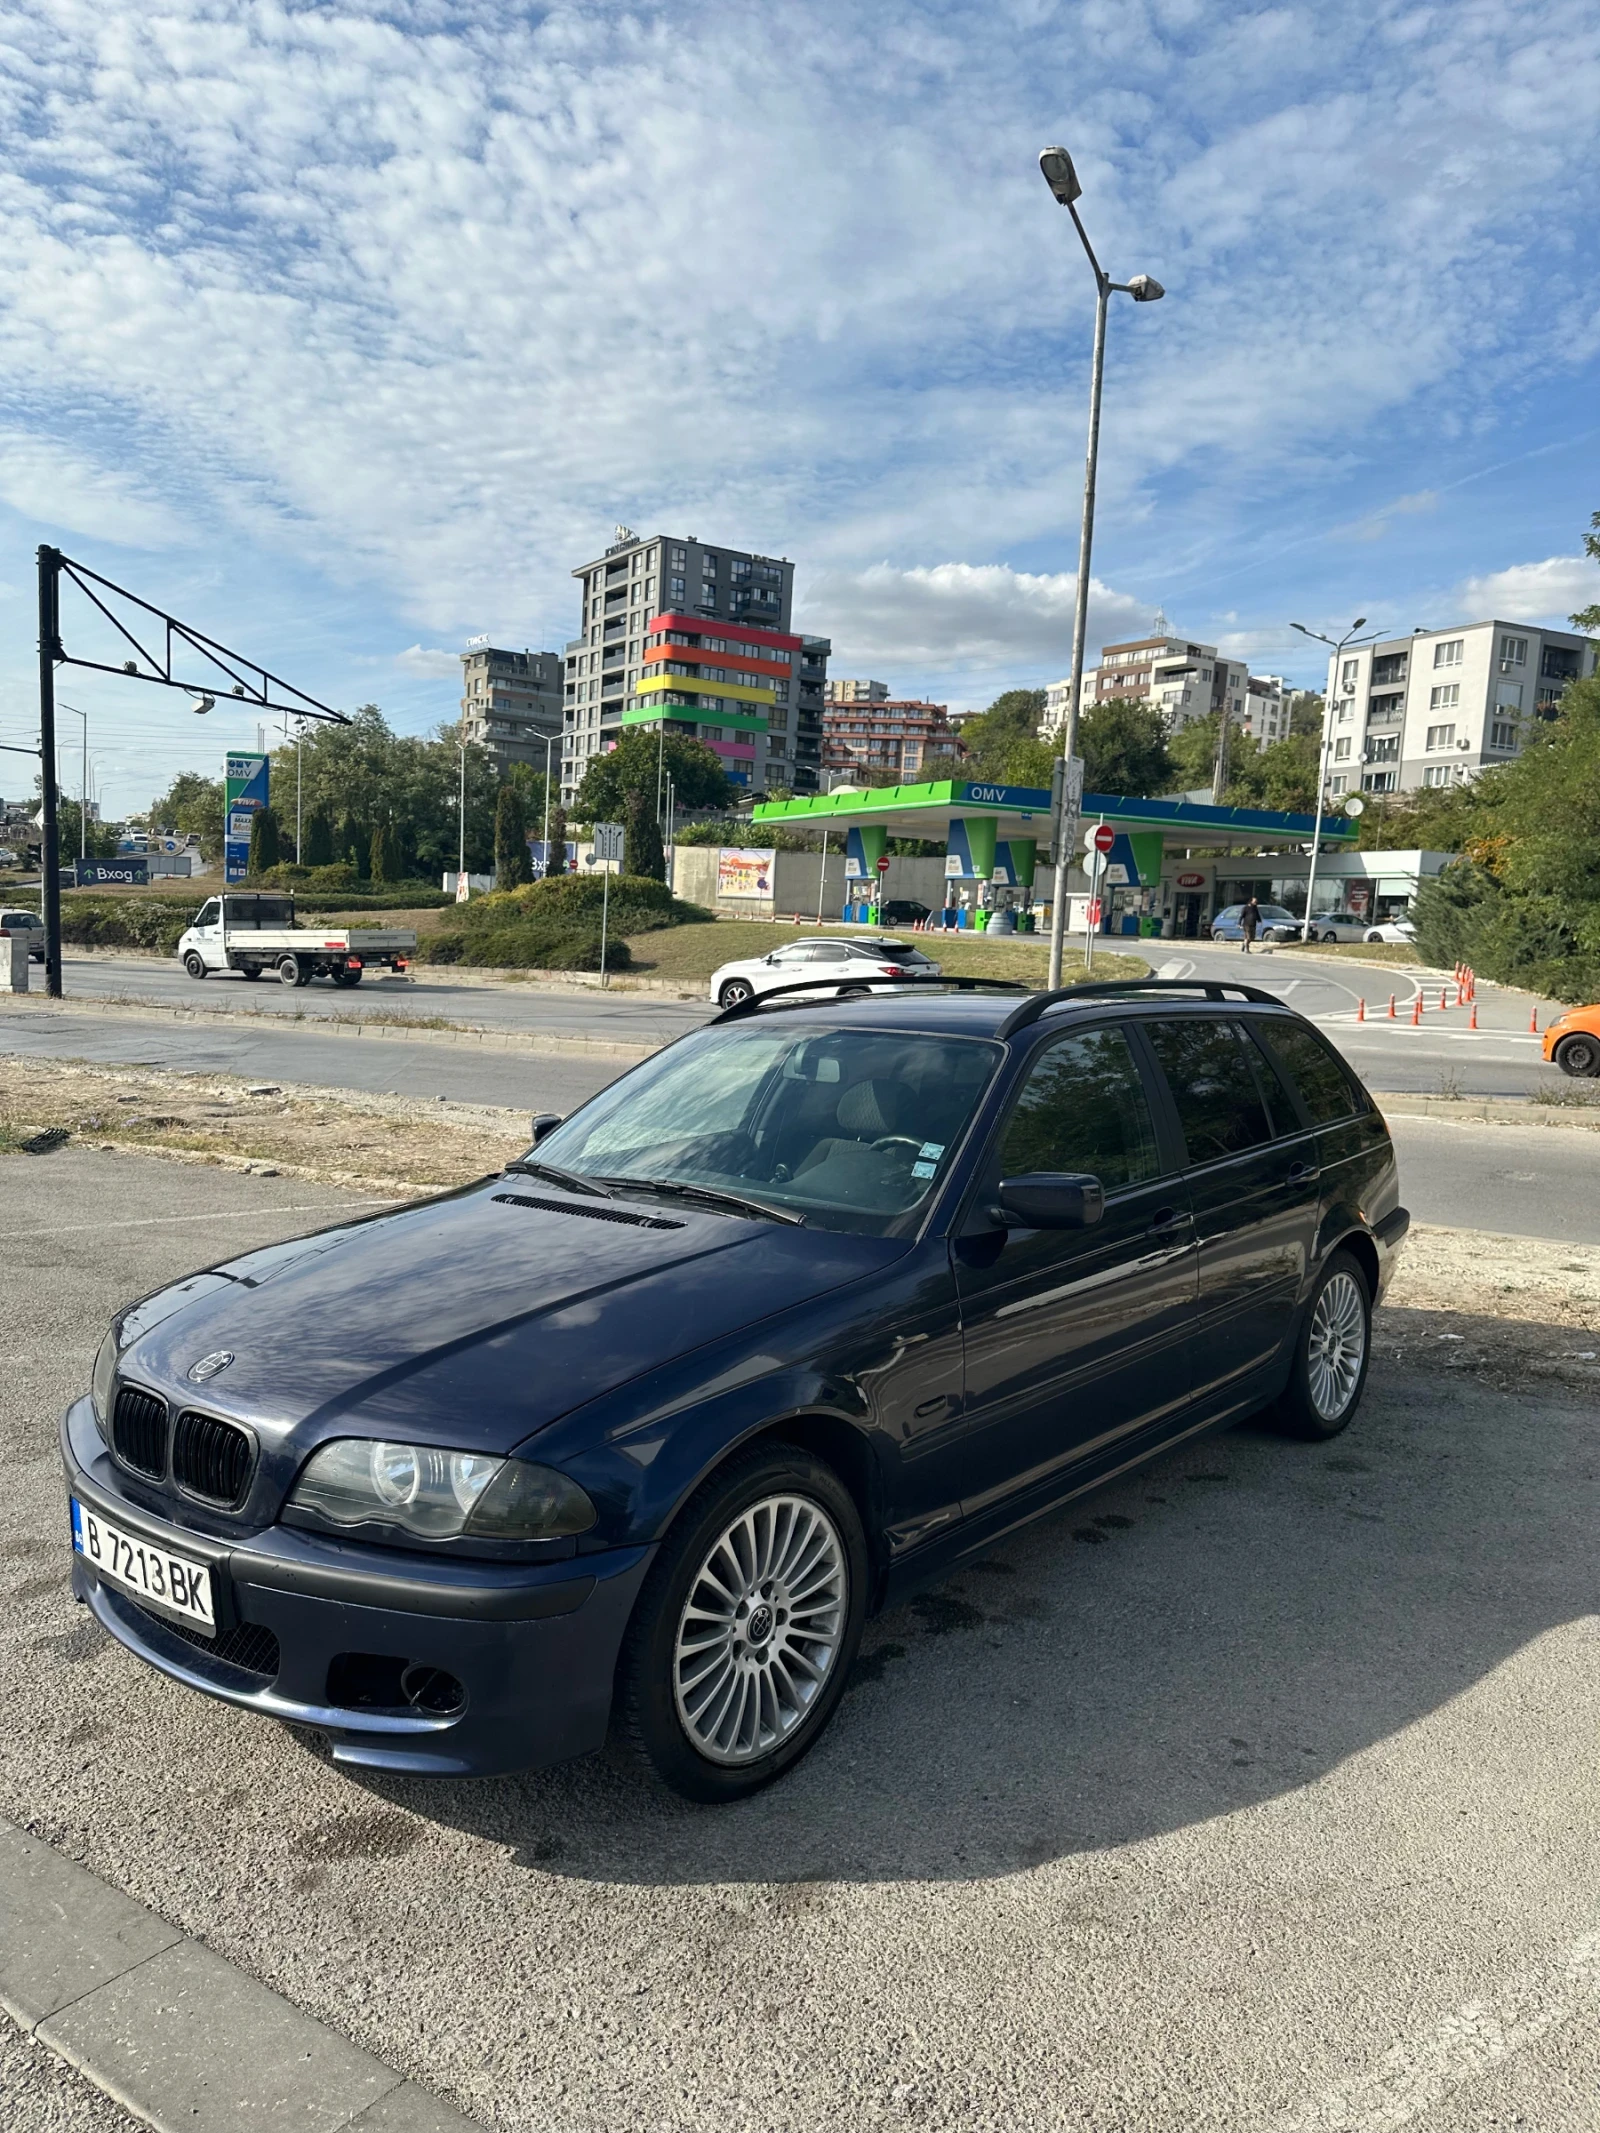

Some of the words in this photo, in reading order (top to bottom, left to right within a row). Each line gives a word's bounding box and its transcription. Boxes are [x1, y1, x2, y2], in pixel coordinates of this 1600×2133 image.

[228, 769, 251, 777] OMV
[971, 787, 1007, 802] OMV
[1180, 875, 1198, 885] VIVA
[87, 1516, 101, 1560] B
